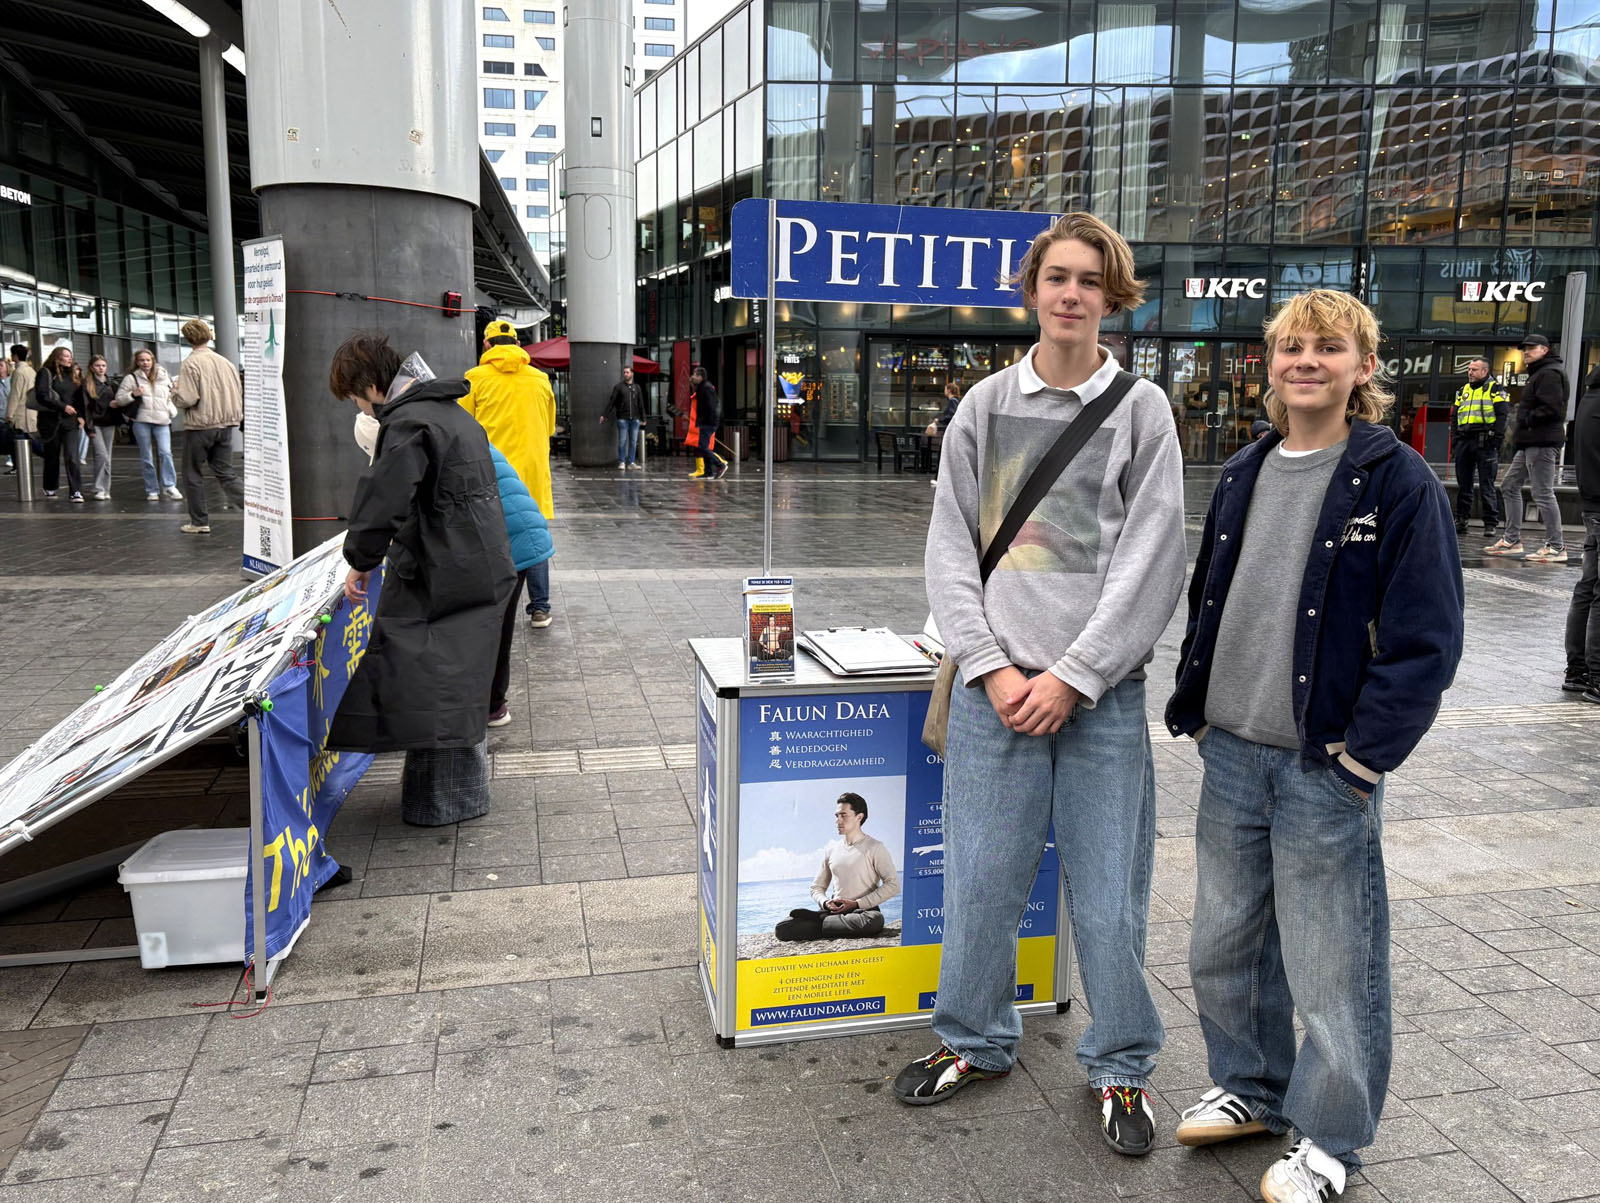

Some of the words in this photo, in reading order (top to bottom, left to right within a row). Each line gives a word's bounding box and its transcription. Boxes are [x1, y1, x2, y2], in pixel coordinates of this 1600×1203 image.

[0, 184, 32, 206] BETON
[775, 216, 1034, 293] PETITI
[1205, 278, 1266, 299] KFC
[1482, 281, 1546, 302] KFC
[759, 704, 827, 724] FALUN
[835, 701, 891, 720] DAFA
[785, 728, 874, 740] WAARACHTIGHEID
[785, 743, 848, 755] MEDEDOGEN
[785, 757, 886, 769] VERDRAAGZAAMHEID
[754, 965, 796, 974] CULTIVATIE
[798, 962, 813, 970] VAN
[815, 959, 849, 968] LICHAAM
[773, 985, 809, 994] ZITTENDE
[811, 981, 849, 990] MEDITATIE
[850, 979, 866, 987] MET
[785, 974, 832, 985] OEFENINGEN
[787, 993, 802, 1001] EEN
[804, 990, 832, 999] MORELE
[834, 988, 852, 996] LEER
[756, 1001, 881, 1021] WWW.FALUNDAFA.ORG
